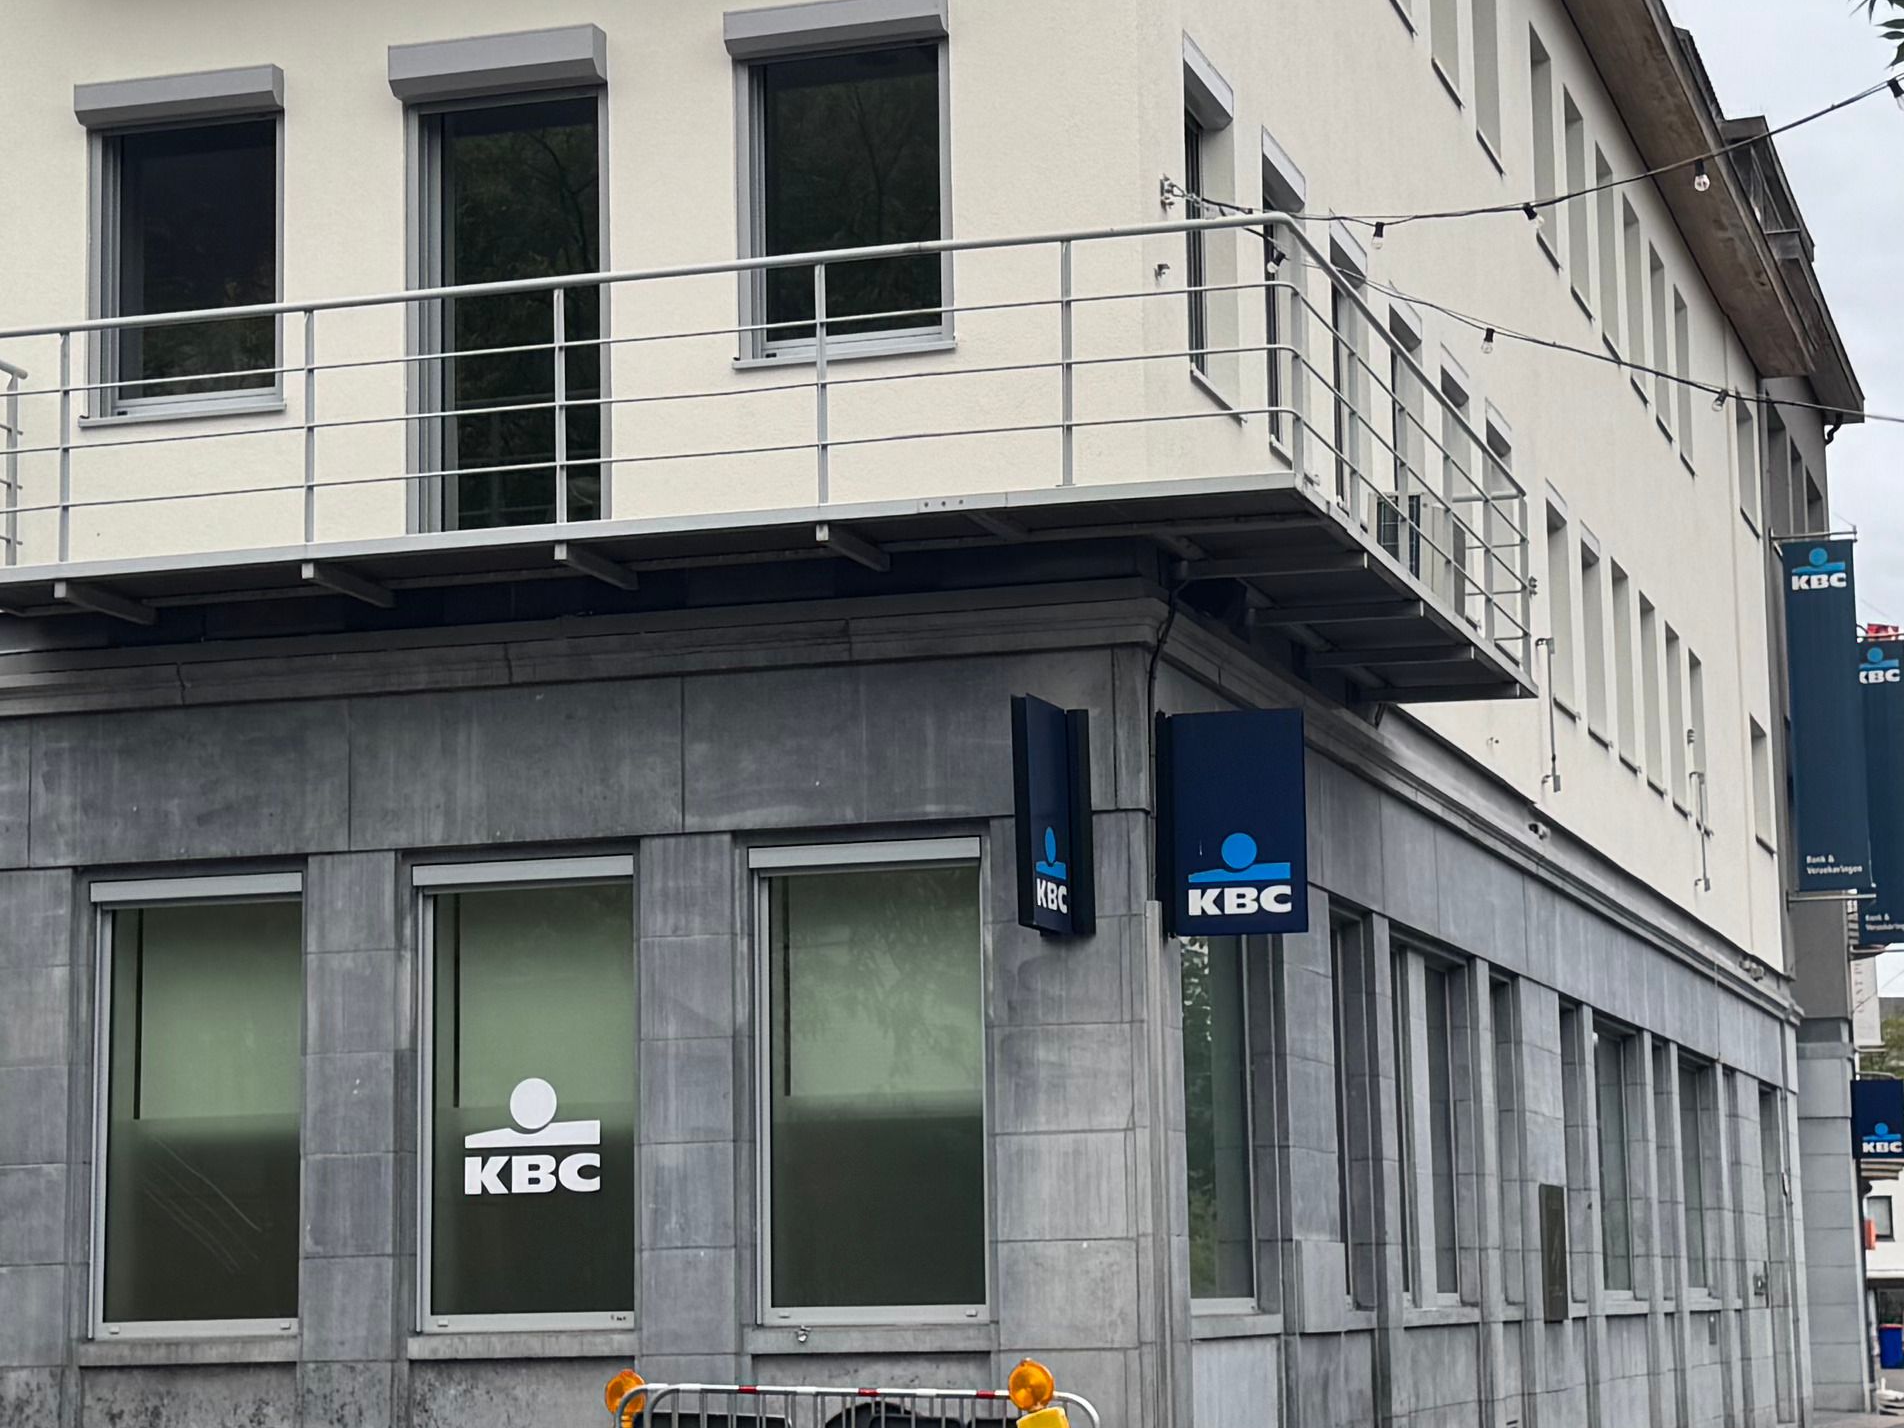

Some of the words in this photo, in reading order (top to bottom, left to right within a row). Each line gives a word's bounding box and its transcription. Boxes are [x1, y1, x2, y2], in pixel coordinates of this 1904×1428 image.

[1791, 572, 1847, 591] KBC
[1036, 878, 1068, 914] KBC
[1188, 885, 1292, 916] KBC
[1862, 1141, 1903, 1153] KBC
[465, 1153, 601, 1195] KBC
